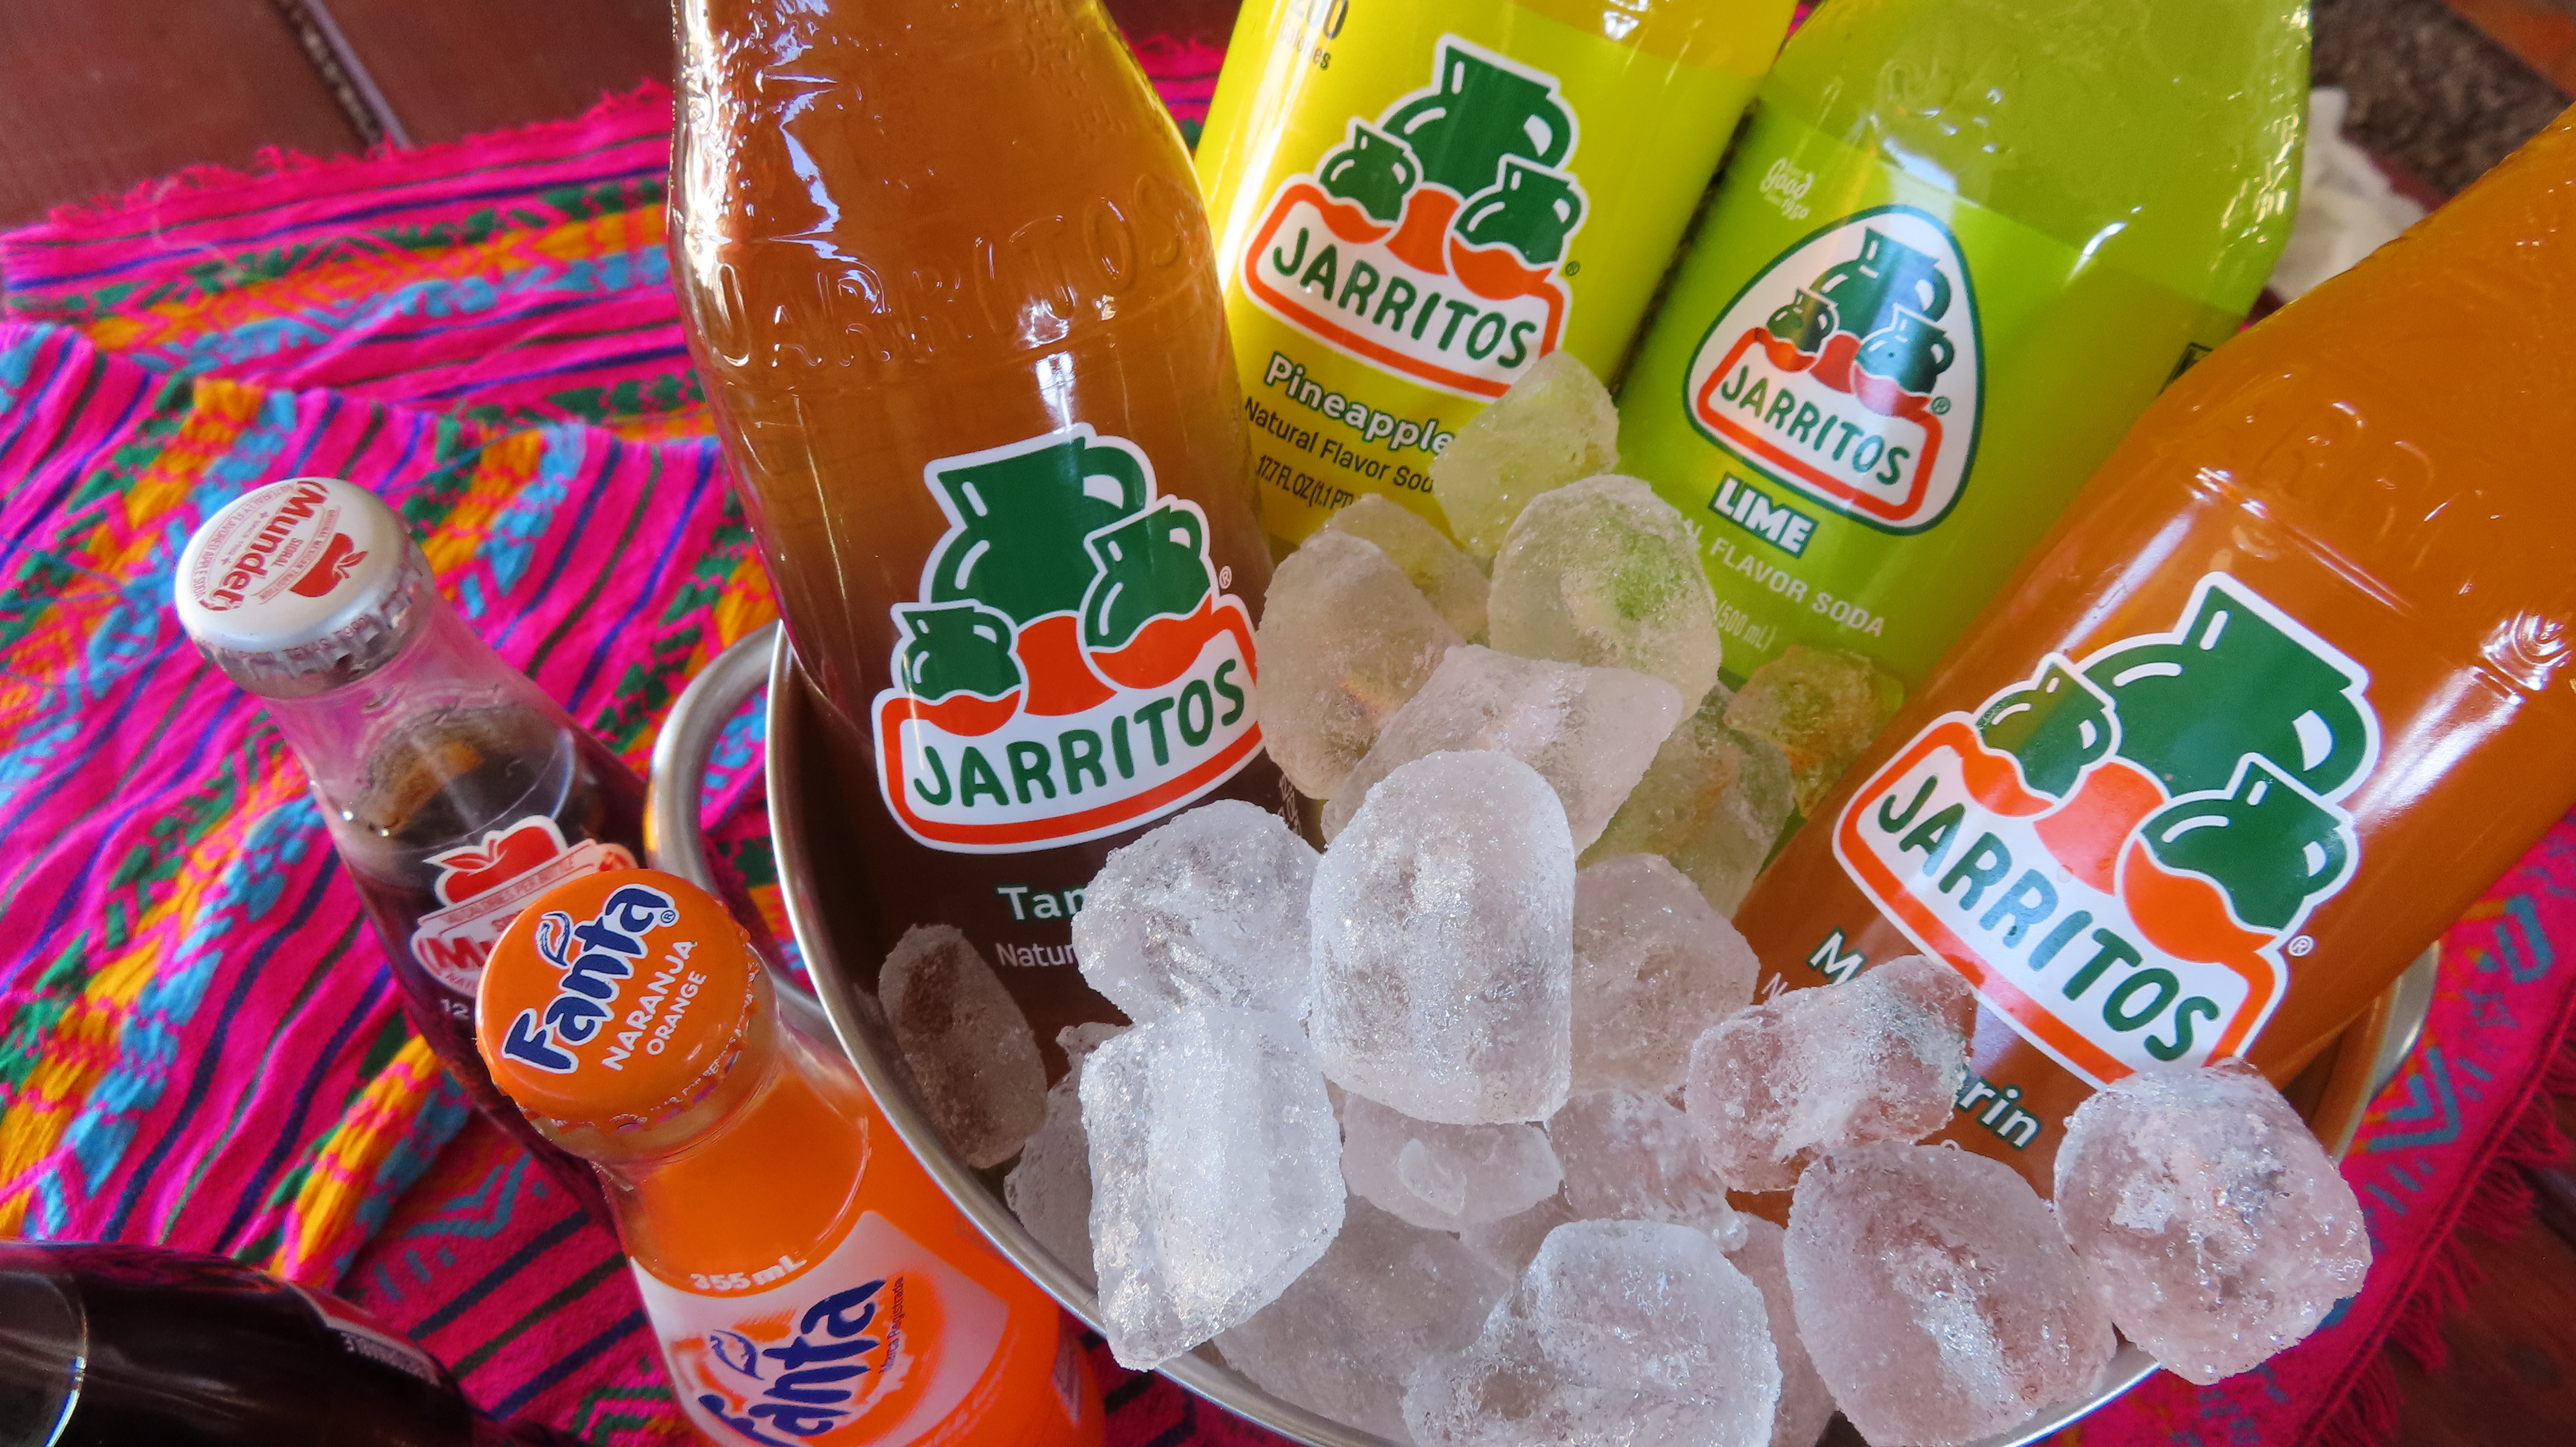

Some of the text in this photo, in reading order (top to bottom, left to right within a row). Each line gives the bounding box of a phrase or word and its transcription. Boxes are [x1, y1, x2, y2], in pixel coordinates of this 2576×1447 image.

[1272, 227, 1538, 369] JARRITOS
[1245, 397, 1434, 493] Natural Flavor Sod
[1264, 351, 1454, 455] Pineapple
[1721, 364, 1910, 486] JARRITOS
[1276, 465, 1292, 491] FL
[1292, 474, 1315, 500] OZ
[1711, 475, 1815, 557] LIME
[213, 487, 328, 607] Mundet
[1709, 537, 1808, 603] FLAVOR
[1812, 591, 1885, 638] SODA
[914, 658, 1245, 807] JARRITOS
[995, 942, 1076, 967] Natur
[1877, 774, 2219, 1061] JARRITOS
[503, 886, 673, 1072] Fanta
[601, 941, 698, 1071] NARANJA
[647, 970, 707, 1055] ORANGE
[689, 1254, 808, 1291] 355 mL
[698, 1278, 887, 1447] Fanta
